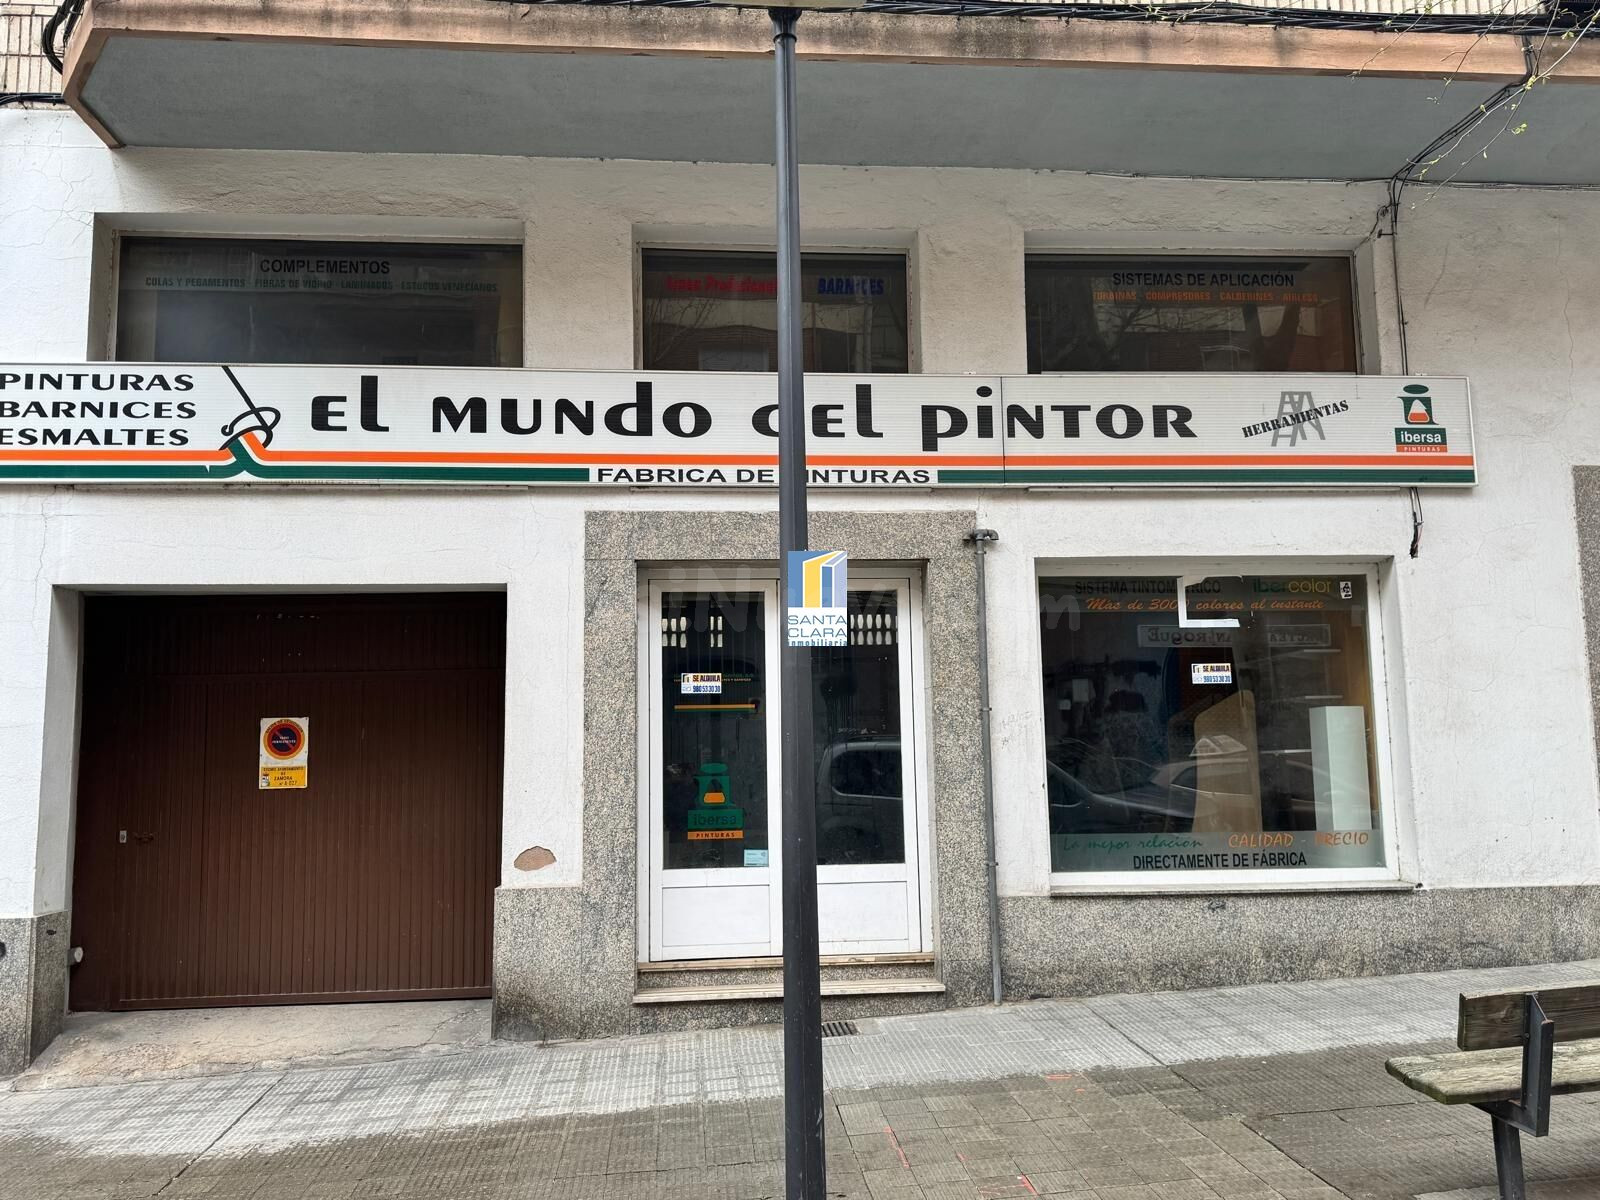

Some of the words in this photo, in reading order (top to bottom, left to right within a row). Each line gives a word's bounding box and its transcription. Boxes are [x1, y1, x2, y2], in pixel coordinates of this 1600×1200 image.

[260, 259, 390, 275] COMPLEMENTOS
[1112, 272, 1183, 287] SISTEMAS
[1187, 273, 1206, 287] DE
[1209, 270, 1294, 287] APLICACIÓN
[0, 373, 194, 391] PINTURAS
[0, 401, 197, 419] BARNICES
[1241, 399, 1350, 439] HERRAMIENTAS
[0, 428, 190, 446] ESMALTES
[1399, 430, 1442, 444] ibersa
[1403, 446, 1441, 454] PINTURAS
[597, 468, 727, 483] FABRICA
[736, 468, 775, 484] DE
[808, 469, 931, 484] INTURAS
[1075, 580, 1129, 594] SISTEMA
[1131, 580, 1221, 594] TINTOMRICO
[1086, 597, 1121, 611] Más
[1127, 598, 1144, 610] de
[1147, 598, 1190, 610] 300
[1195, 598, 1245, 610] colores
[1250, 599, 1265, 610] al
[1271, 599, 1325, 611] instante
[692, 674, 700, 682] SE
[700, 674, 721, 682] ALQUILA
[693, 814, 737, 826] ibersa
[1228, 832, 1295, 849] CALIDAD
[1314, 831, 1369, 847] PRECIO
[1132, 852, 1230, 870] DIRECTAMENTE
[1231, 852, 1251, 868] DE
[1252, 848, 1308, 868] FÁBRICA
